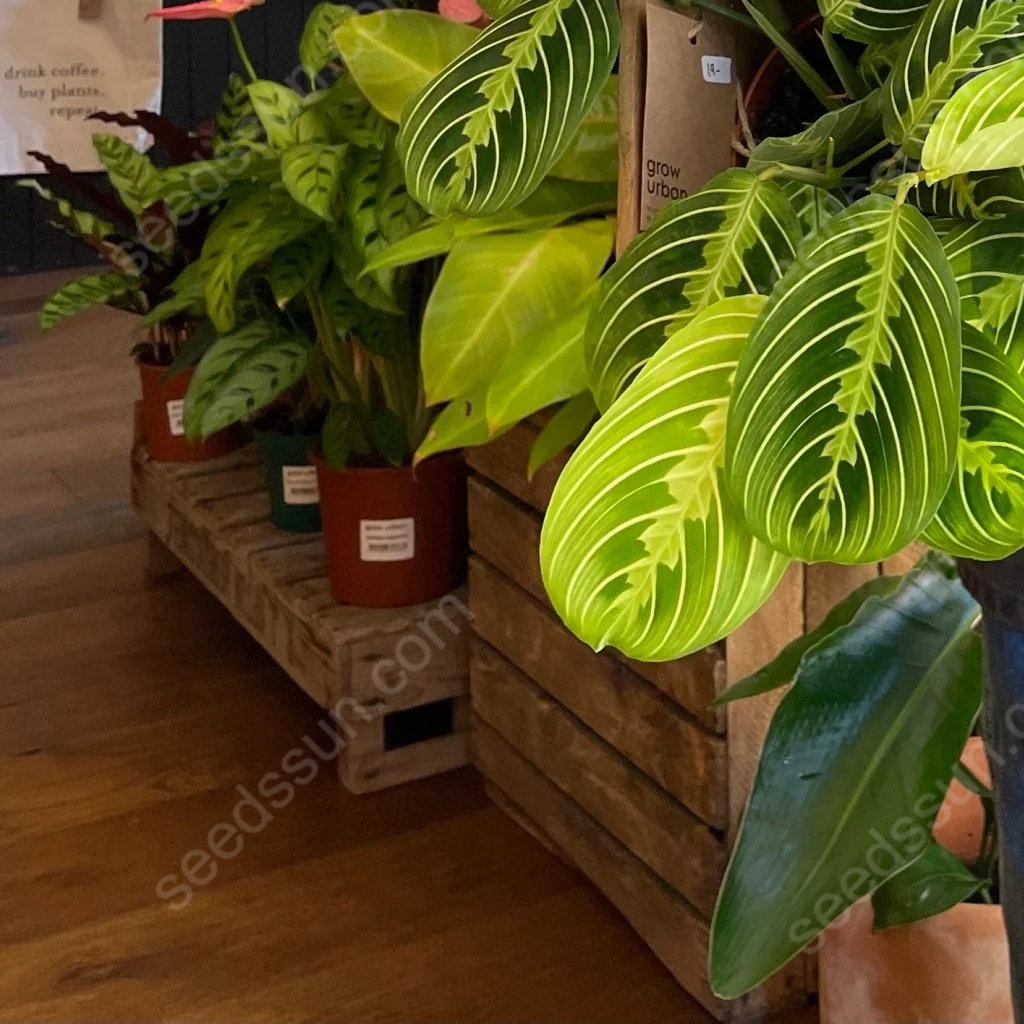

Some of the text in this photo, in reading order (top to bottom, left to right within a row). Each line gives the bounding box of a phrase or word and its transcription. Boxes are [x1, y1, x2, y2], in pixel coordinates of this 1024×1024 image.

[4, 63, 46, 80] drink
[19, 84, 46, 102] buy
[647, 159, 680, 179] grow
[647, 180, 688, 200] urban
